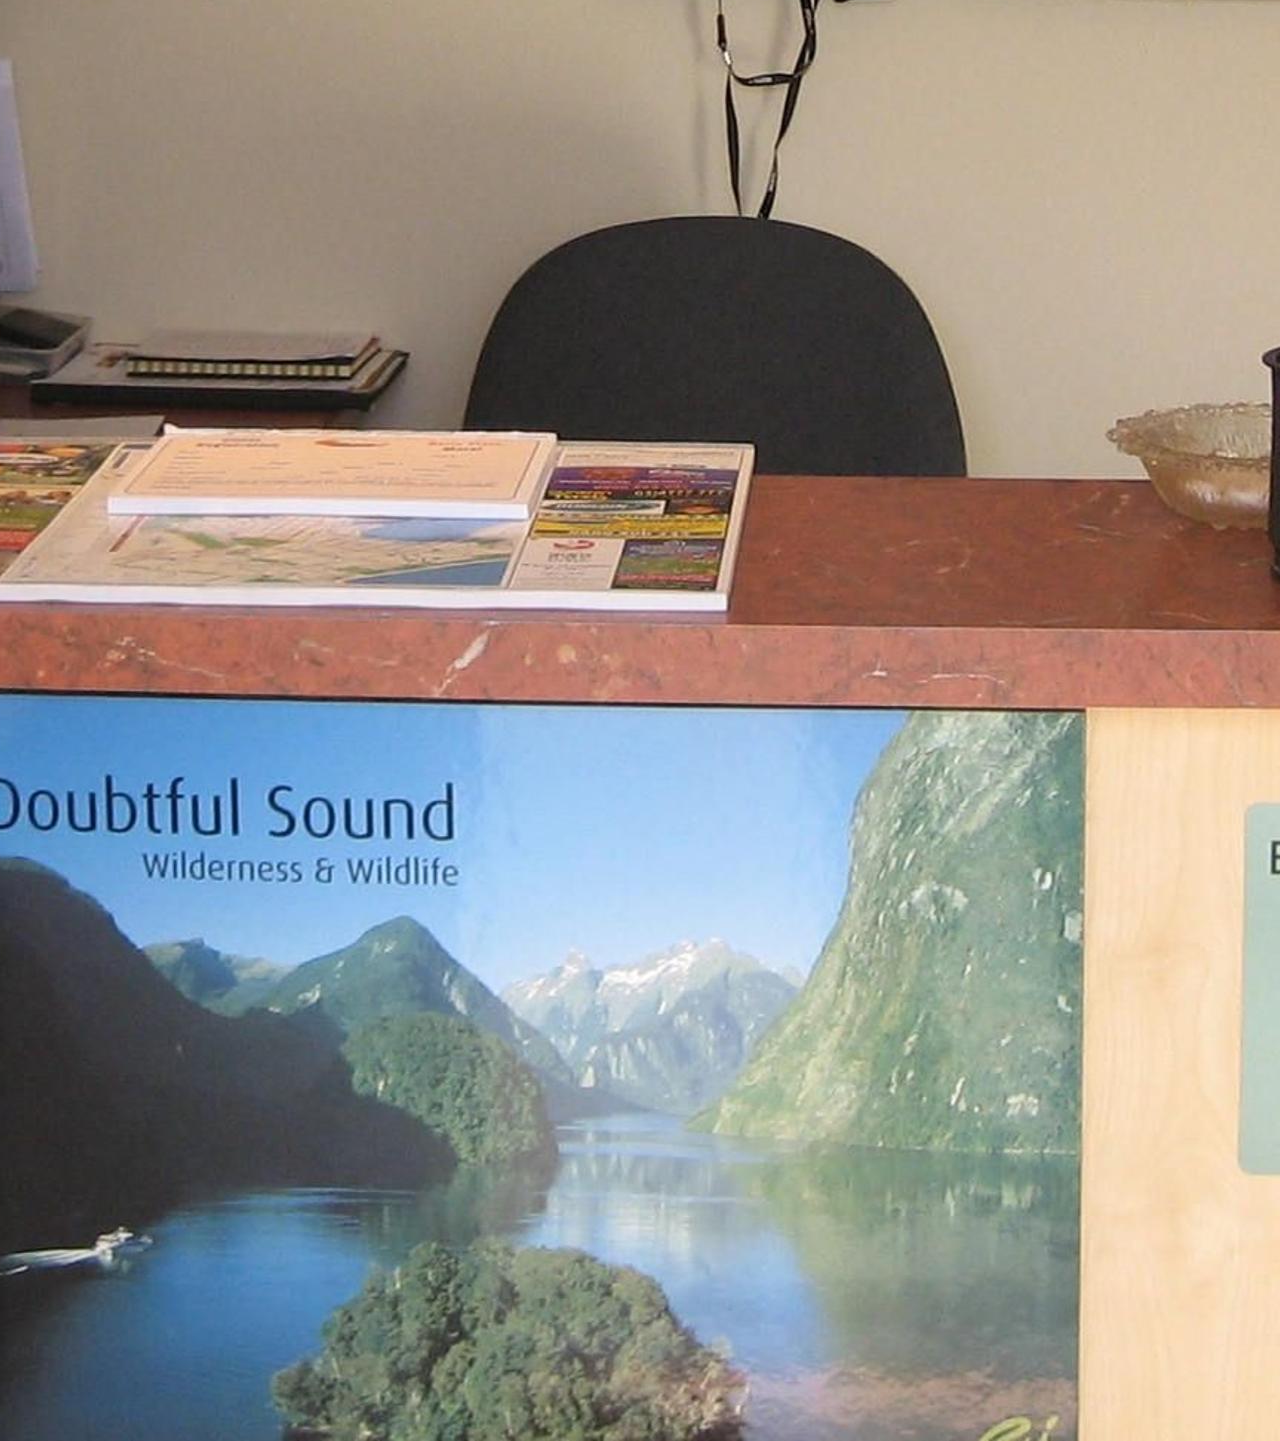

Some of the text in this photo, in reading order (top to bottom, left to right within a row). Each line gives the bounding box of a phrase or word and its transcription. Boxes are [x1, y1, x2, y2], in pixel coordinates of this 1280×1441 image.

[266, 781, 456, 842] Sound
[141, 851, 460, 888] Wilderness & Wildlife
